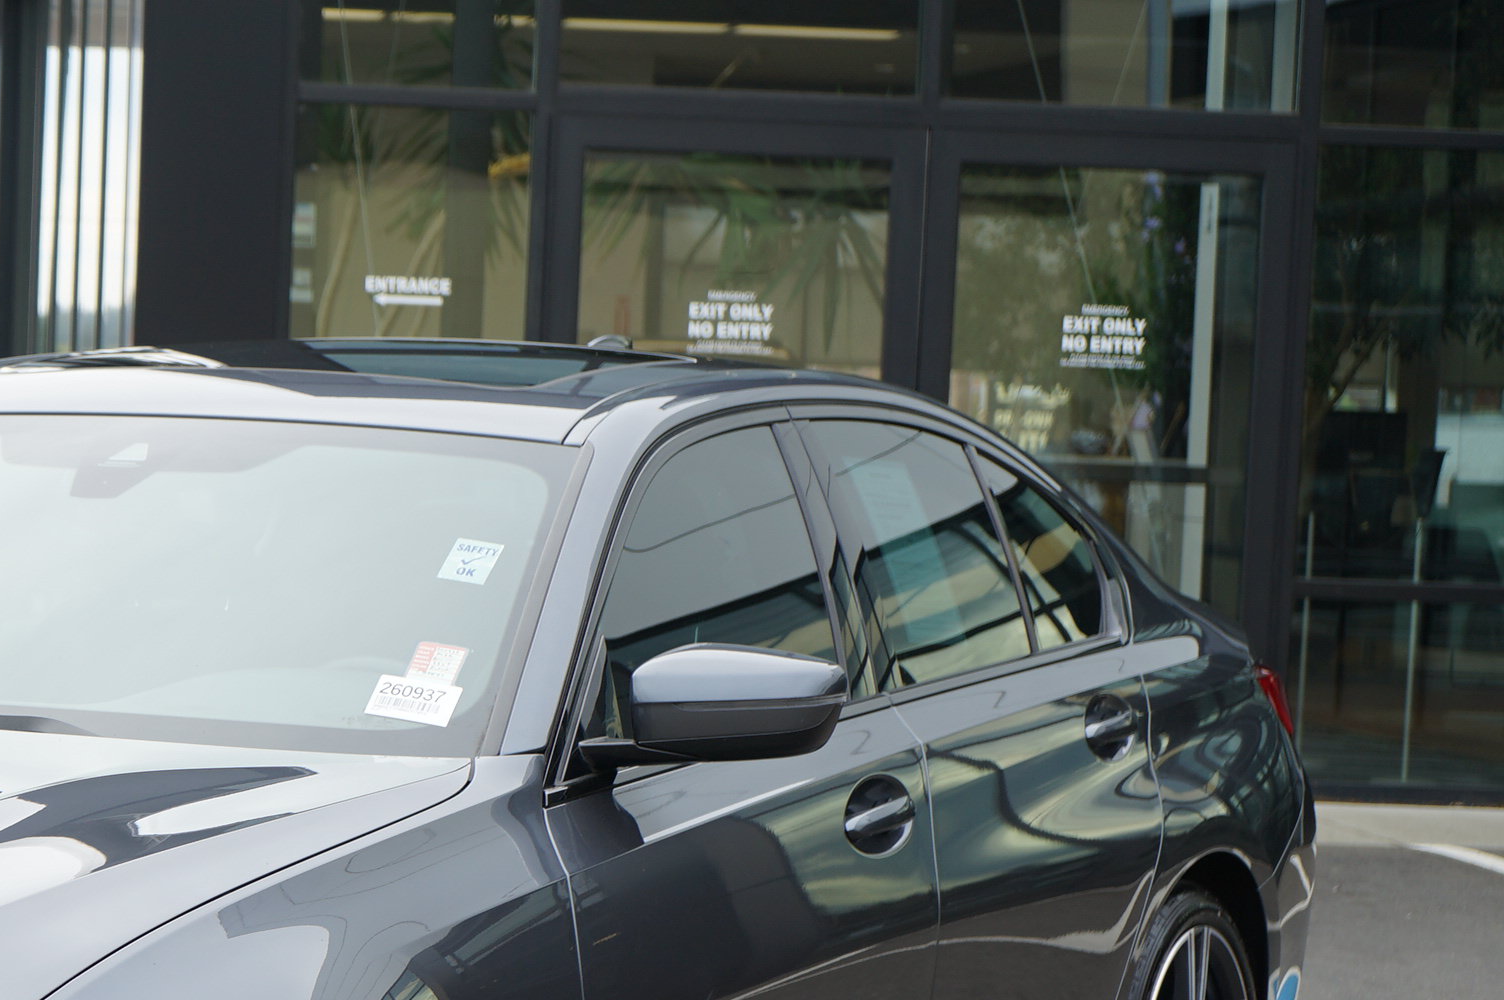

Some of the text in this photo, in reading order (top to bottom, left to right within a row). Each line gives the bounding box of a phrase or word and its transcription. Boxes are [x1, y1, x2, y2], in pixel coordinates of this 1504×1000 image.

[364, 275, 452, 295] ENTRANCE
[688, 301, 774, 321] EXIT ONLY
[687, 320, 773, 340] NO ENTRY
[1062, 315, 1147, 336] EXIT ONLY
[1061, 334, 1146, 355] NO ENTRY
[457, 543, 499, 556] SAFETY
[456, 567, 476, 577] OK
[379, 681, 447, 703] 260937
